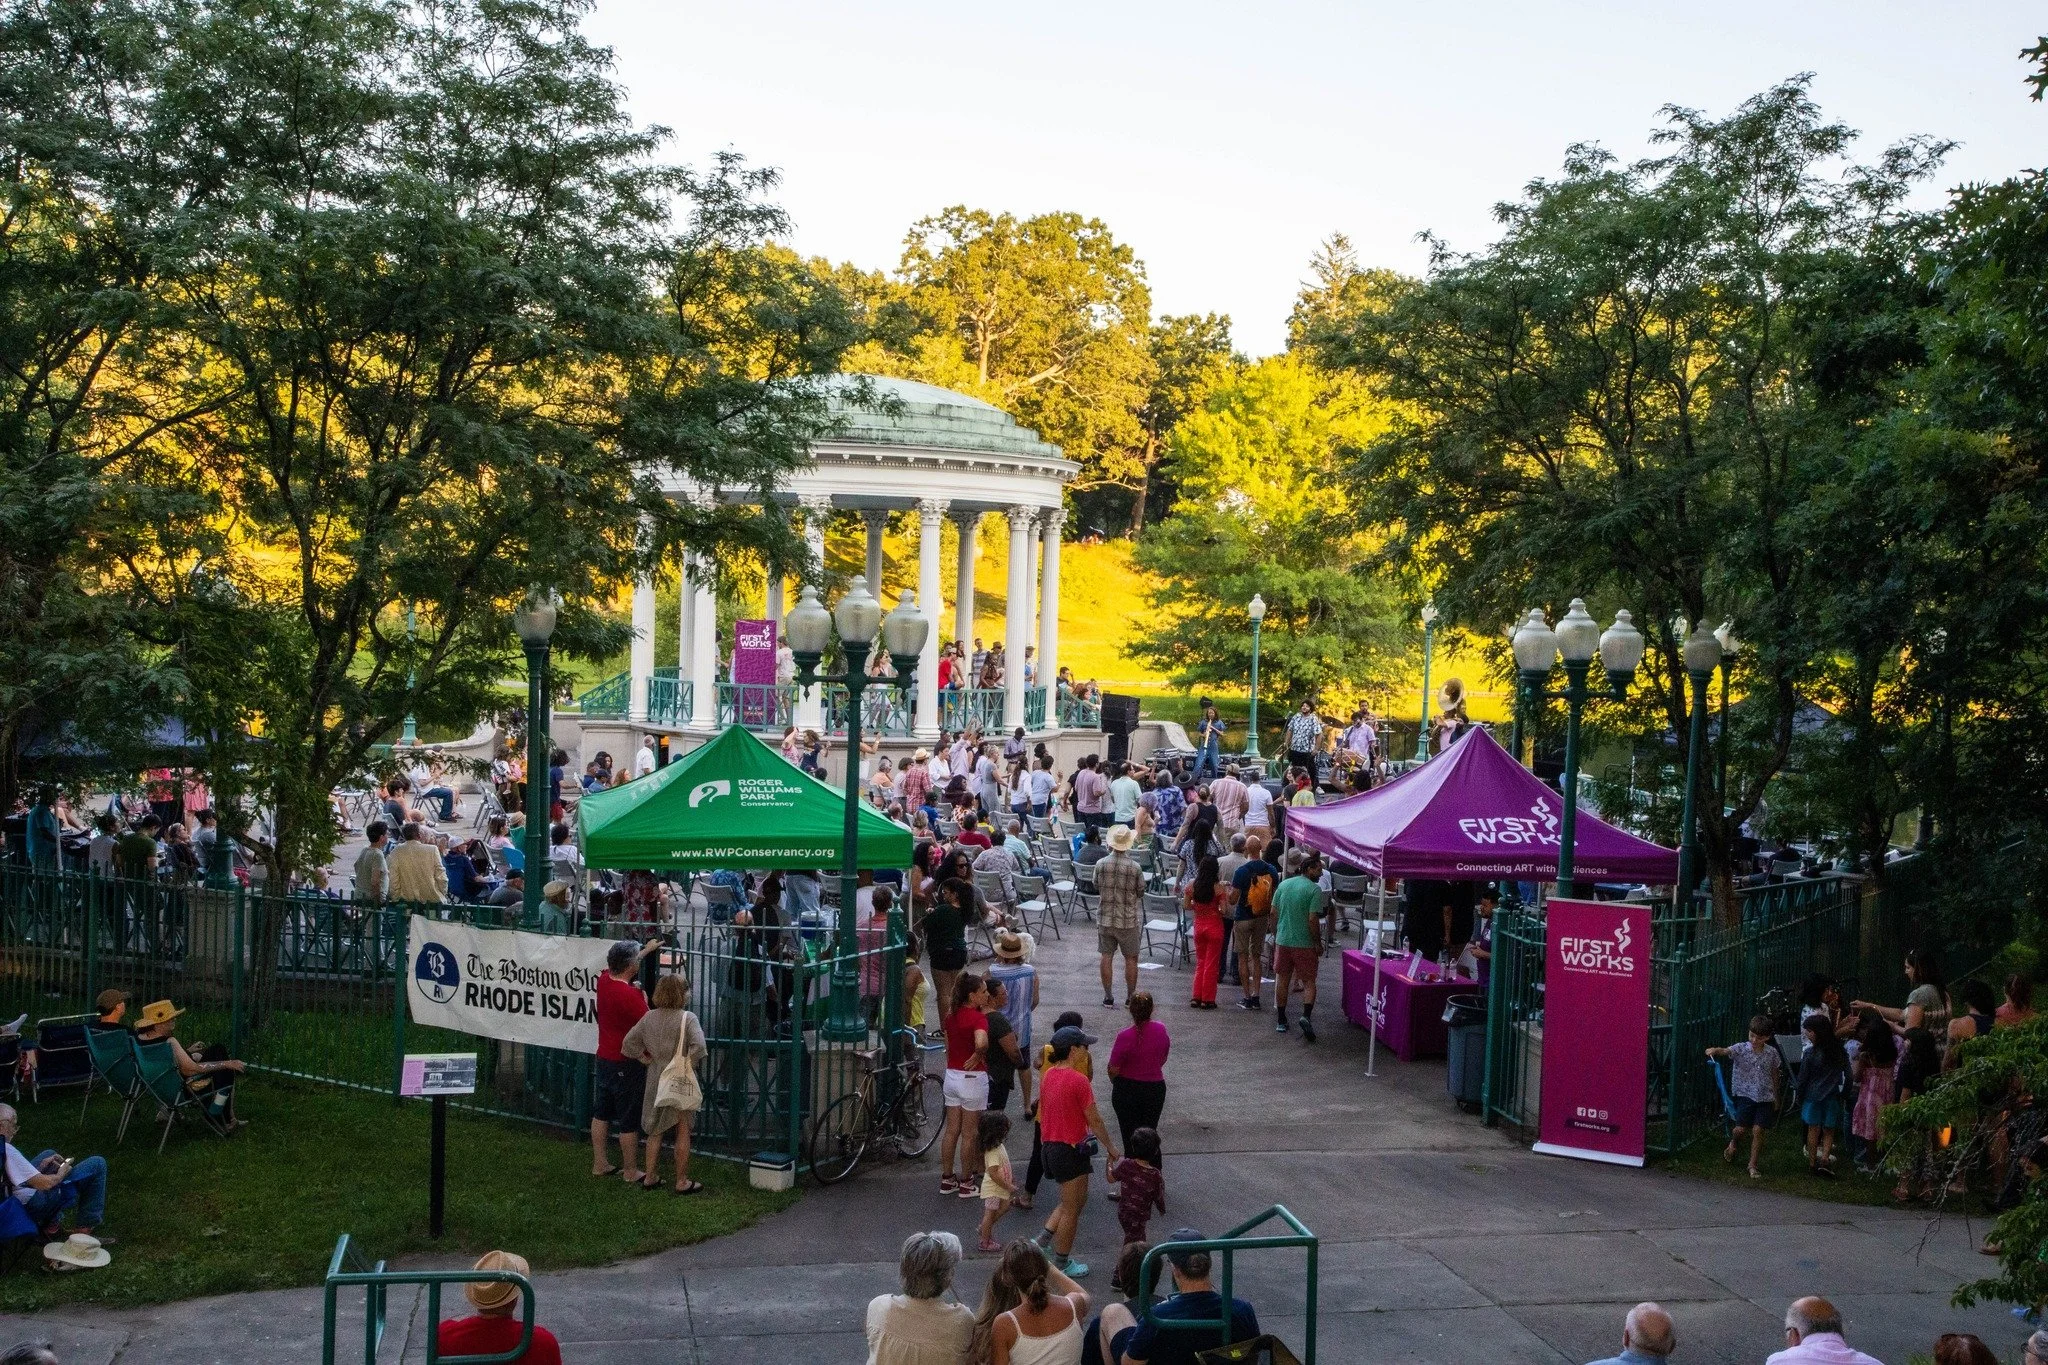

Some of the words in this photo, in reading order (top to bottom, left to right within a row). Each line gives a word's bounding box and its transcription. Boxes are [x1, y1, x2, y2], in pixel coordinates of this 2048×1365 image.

[739, 786, 803, 794] WILLIAMS
[1464, 830, 1578, 847] WORK
[671, 847, 835, 858] www.RWPConservancy.org
[1456, 862, 1512, 874] Connecting
[1515, 863, 1534, 873] ART
[1536, 864, 1556, 873] with
[427, 950, 445, 978] B
[498, 958, 563, 990] Boston
[564, 966, 604, 994] Glo
[465, 982, 536, 1016] RHODE
[541, 993, 599, 1024] ISLAN
